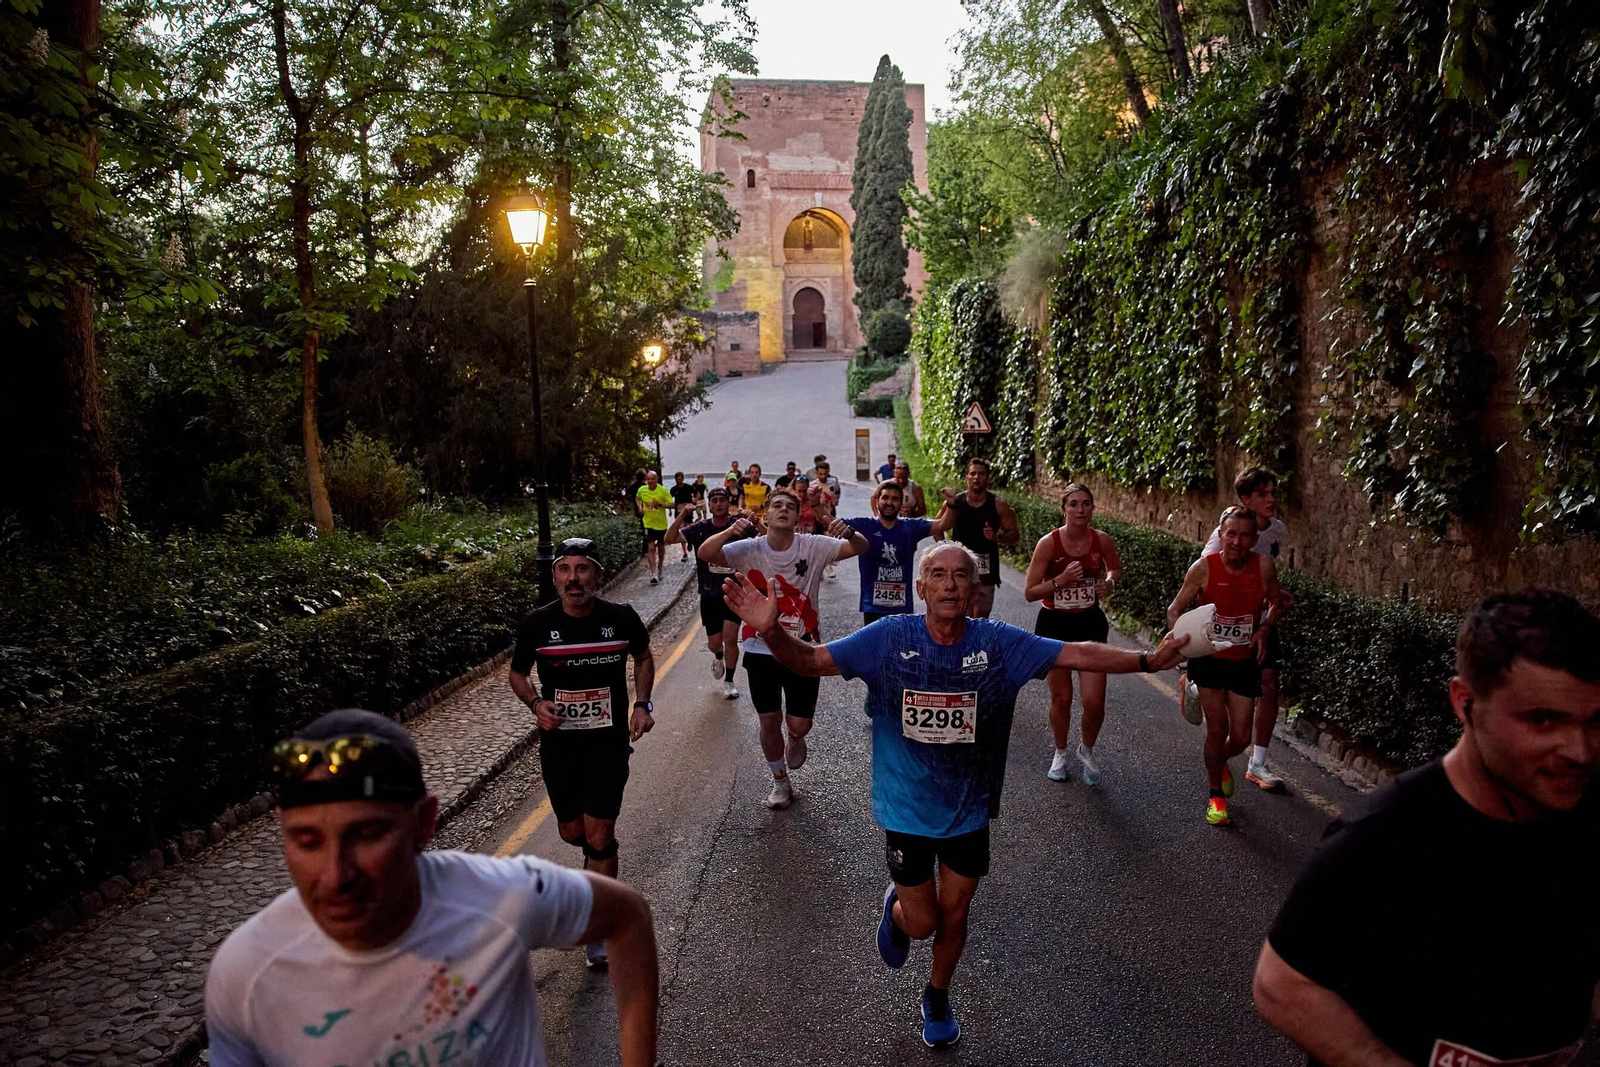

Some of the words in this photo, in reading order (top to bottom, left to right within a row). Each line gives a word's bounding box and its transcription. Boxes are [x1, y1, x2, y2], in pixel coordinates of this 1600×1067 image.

[877, 566, 903, 581] Alcalá
[875, 590, 901, 600] 2456
[1056, 588, 1088, 601] 3313
[1213, 624, 1241, 637] 976
[967, 656, 984, 665] LOJA
[556, 692, 565, 701] 41
[906, 694, 917, 705] 41
[557, 702, 602, 719] 2625
[905, 707, 964, 729] 3298
[1438, 1050, 1468, 1067] 41
